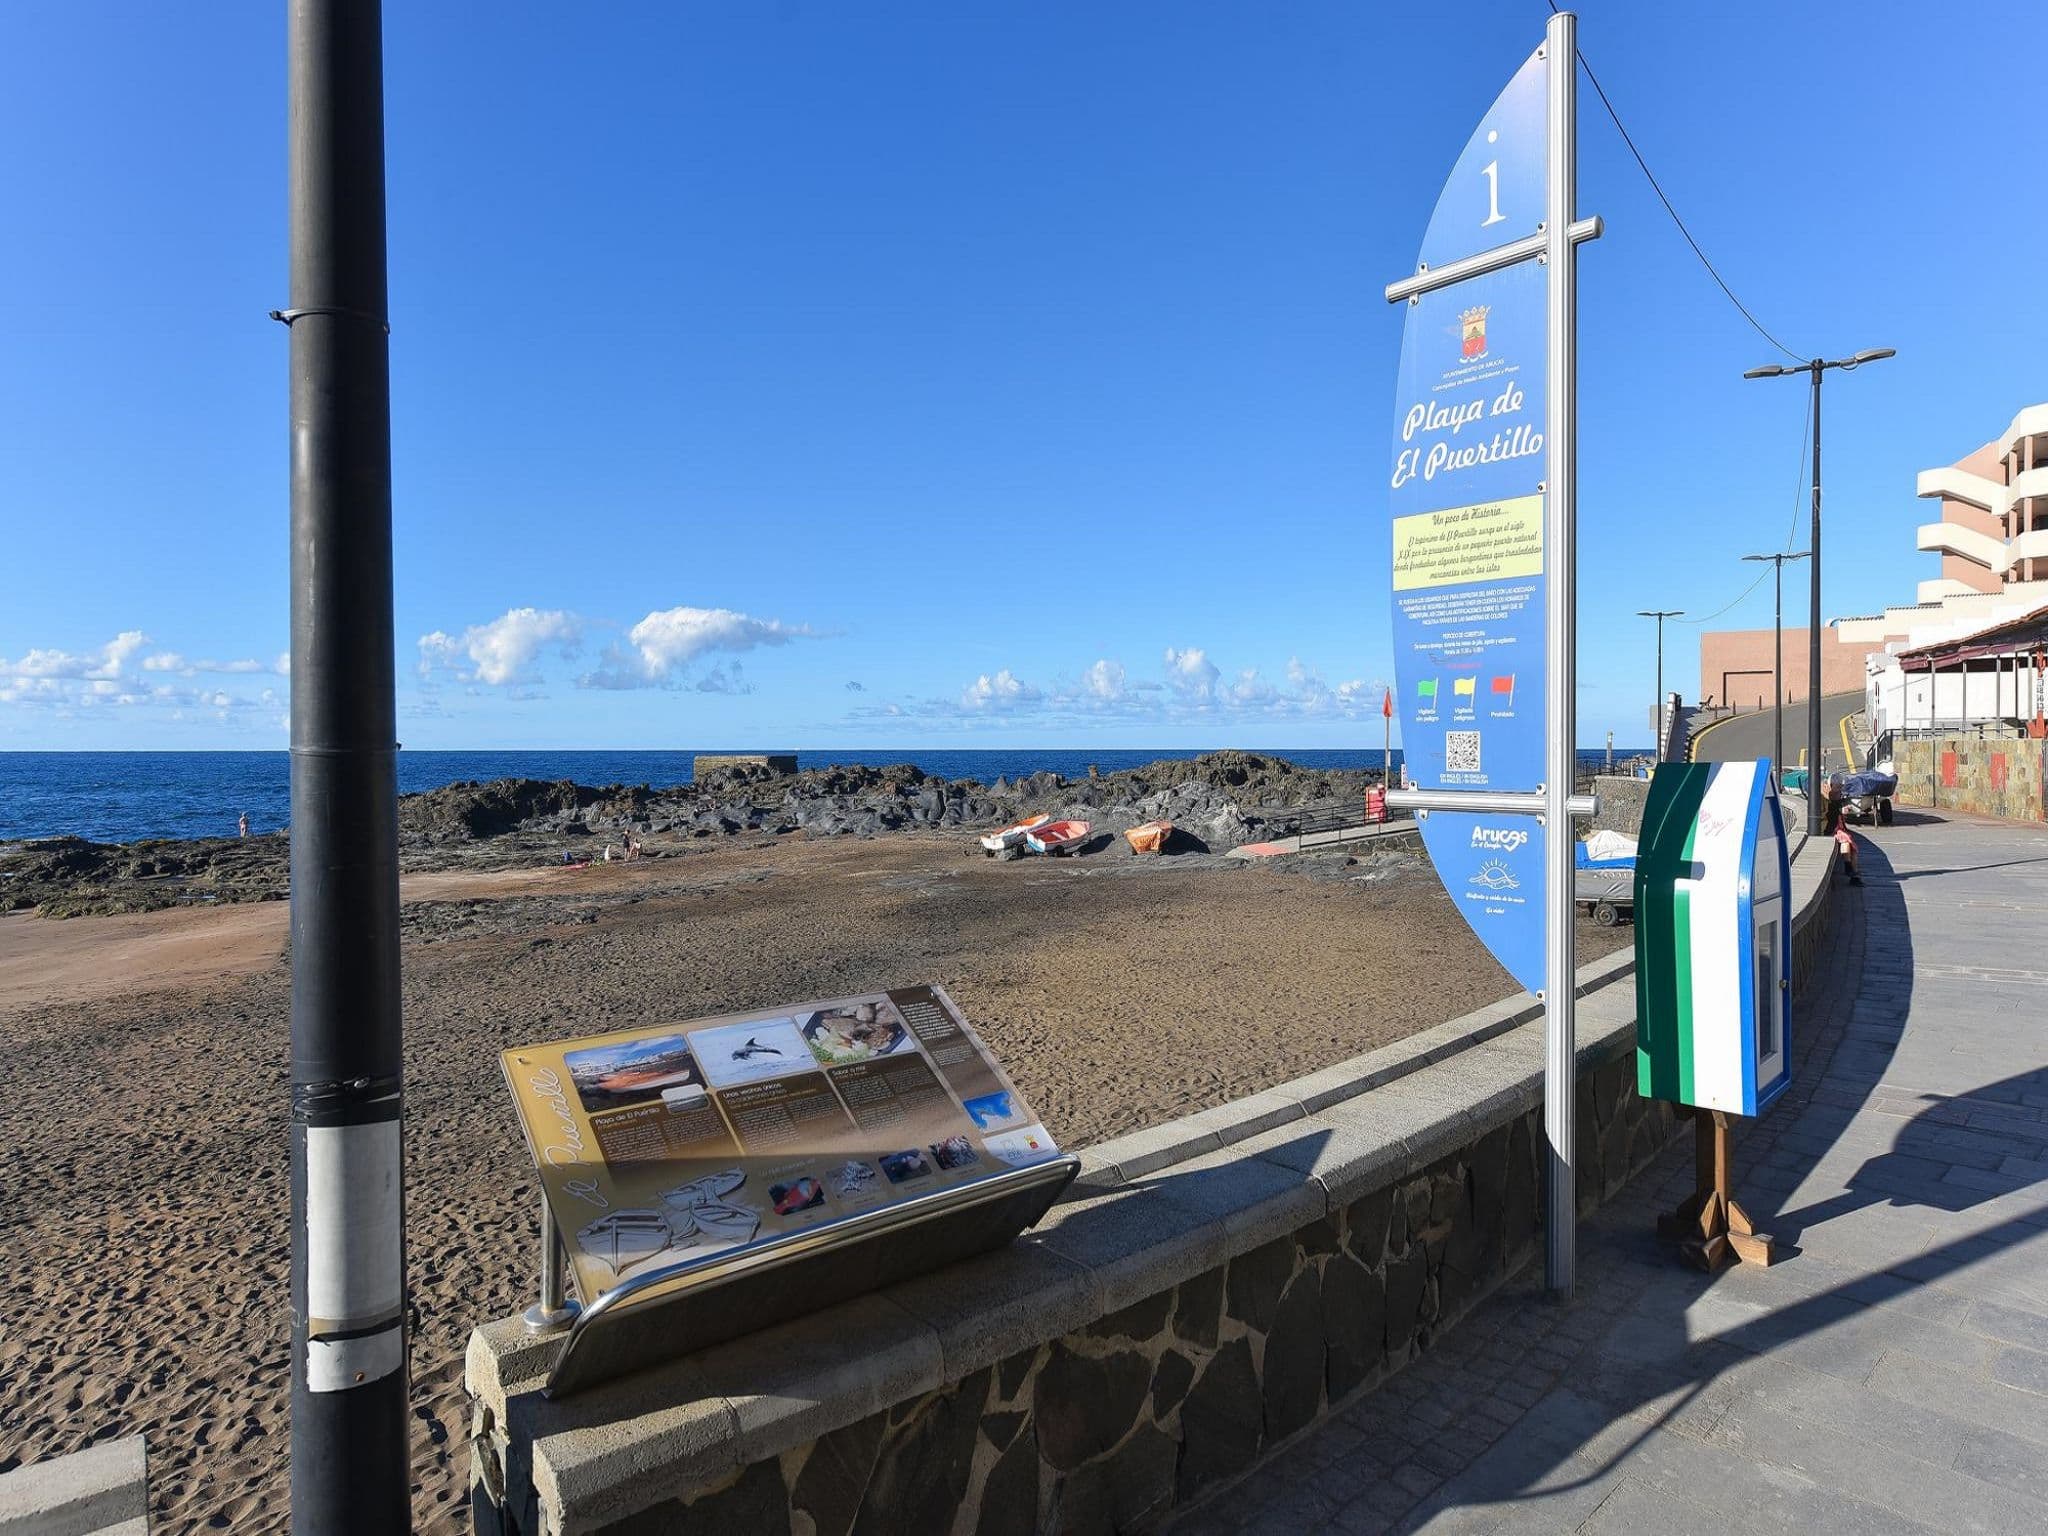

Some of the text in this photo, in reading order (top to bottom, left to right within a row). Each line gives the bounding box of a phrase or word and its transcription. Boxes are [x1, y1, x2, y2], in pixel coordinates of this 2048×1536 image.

[1481, 129, 1506, 227] i
[1402, 381, 1524, 442] Playa de
[1391, 424, 1544, 488] El Puertillo
[1445, 515, 1459, 527] poco
[1472, 825, 1528, 852] Arucas
